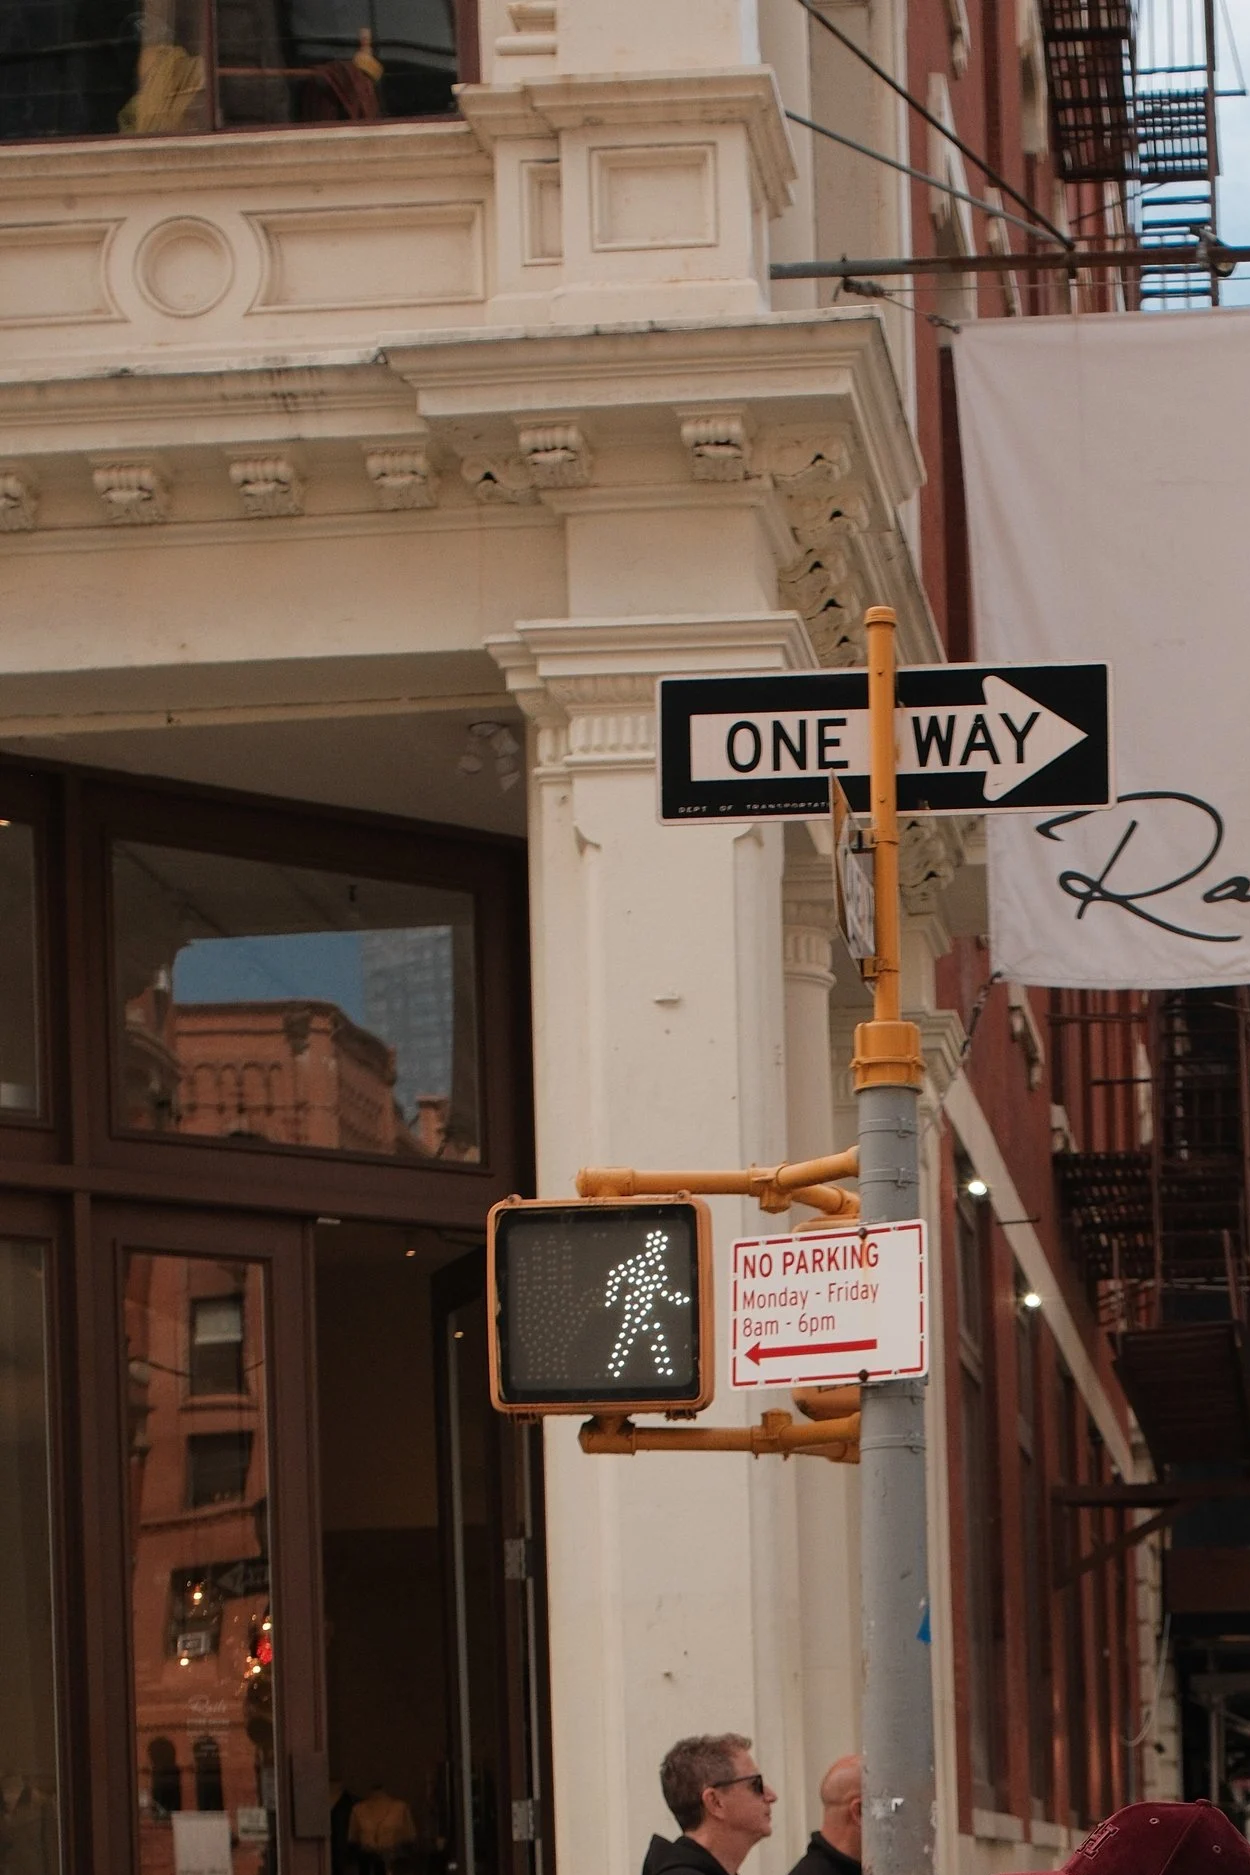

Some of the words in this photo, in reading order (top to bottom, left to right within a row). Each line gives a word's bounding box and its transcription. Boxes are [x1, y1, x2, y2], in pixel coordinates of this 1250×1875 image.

[726, 718, 849, 773] ONE
[911, 712, 1042, 768] WAY
[719, 804, 734, 812] OF
[746, 801, 828, 810] TRANSPORTAT
[743, 1253, 773, 1280] NO
[782, 1242, 880, 1276] PARKING
[743, 1286, 809, 1310] Monday
[828, 1281, 880, 1304] Friday
[743, 1317, 779, 1337] 8am
[798, 1312, 836, 1337] 6pm
